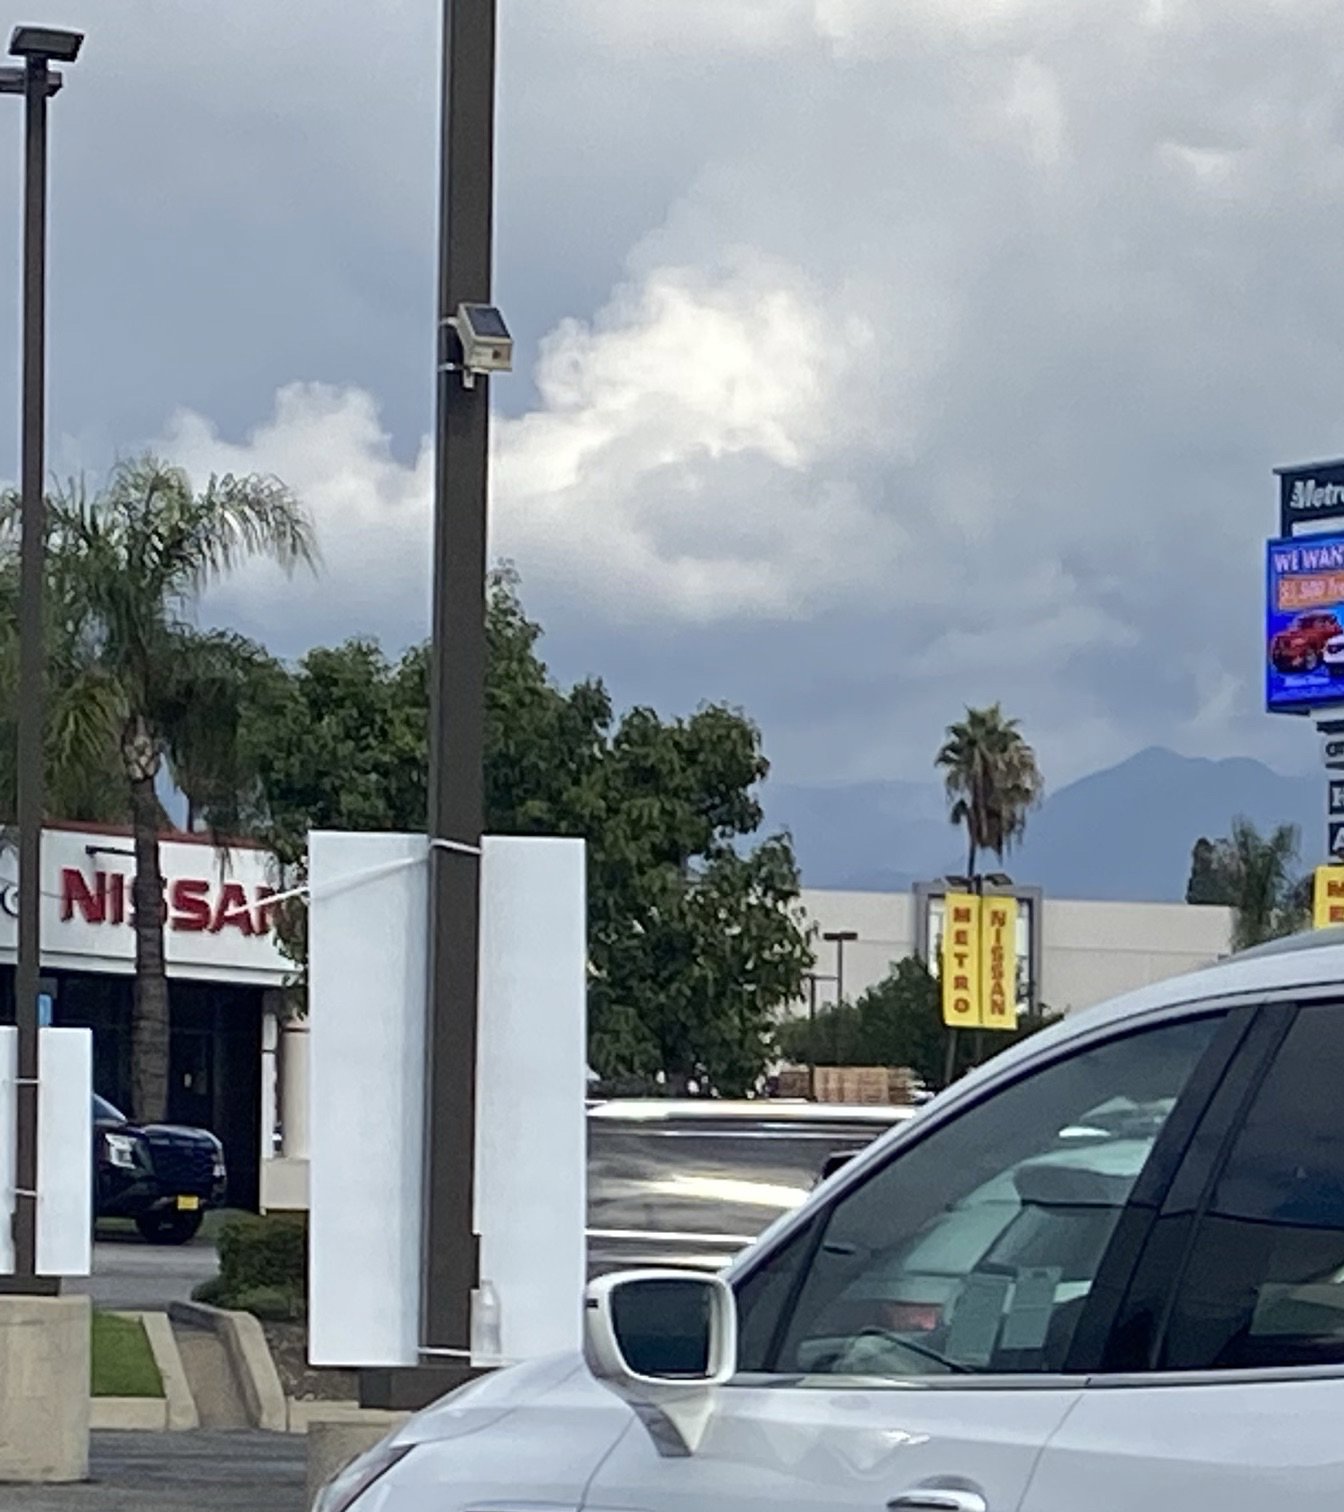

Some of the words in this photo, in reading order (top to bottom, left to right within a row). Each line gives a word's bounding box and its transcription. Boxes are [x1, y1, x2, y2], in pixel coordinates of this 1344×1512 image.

[1274, 550, 1299, 573] WE
[61, 868, 282, 936] NISA
[953, 906, 971, 1013] METRO
[990, 910, 1006, 1015] NISSAN
